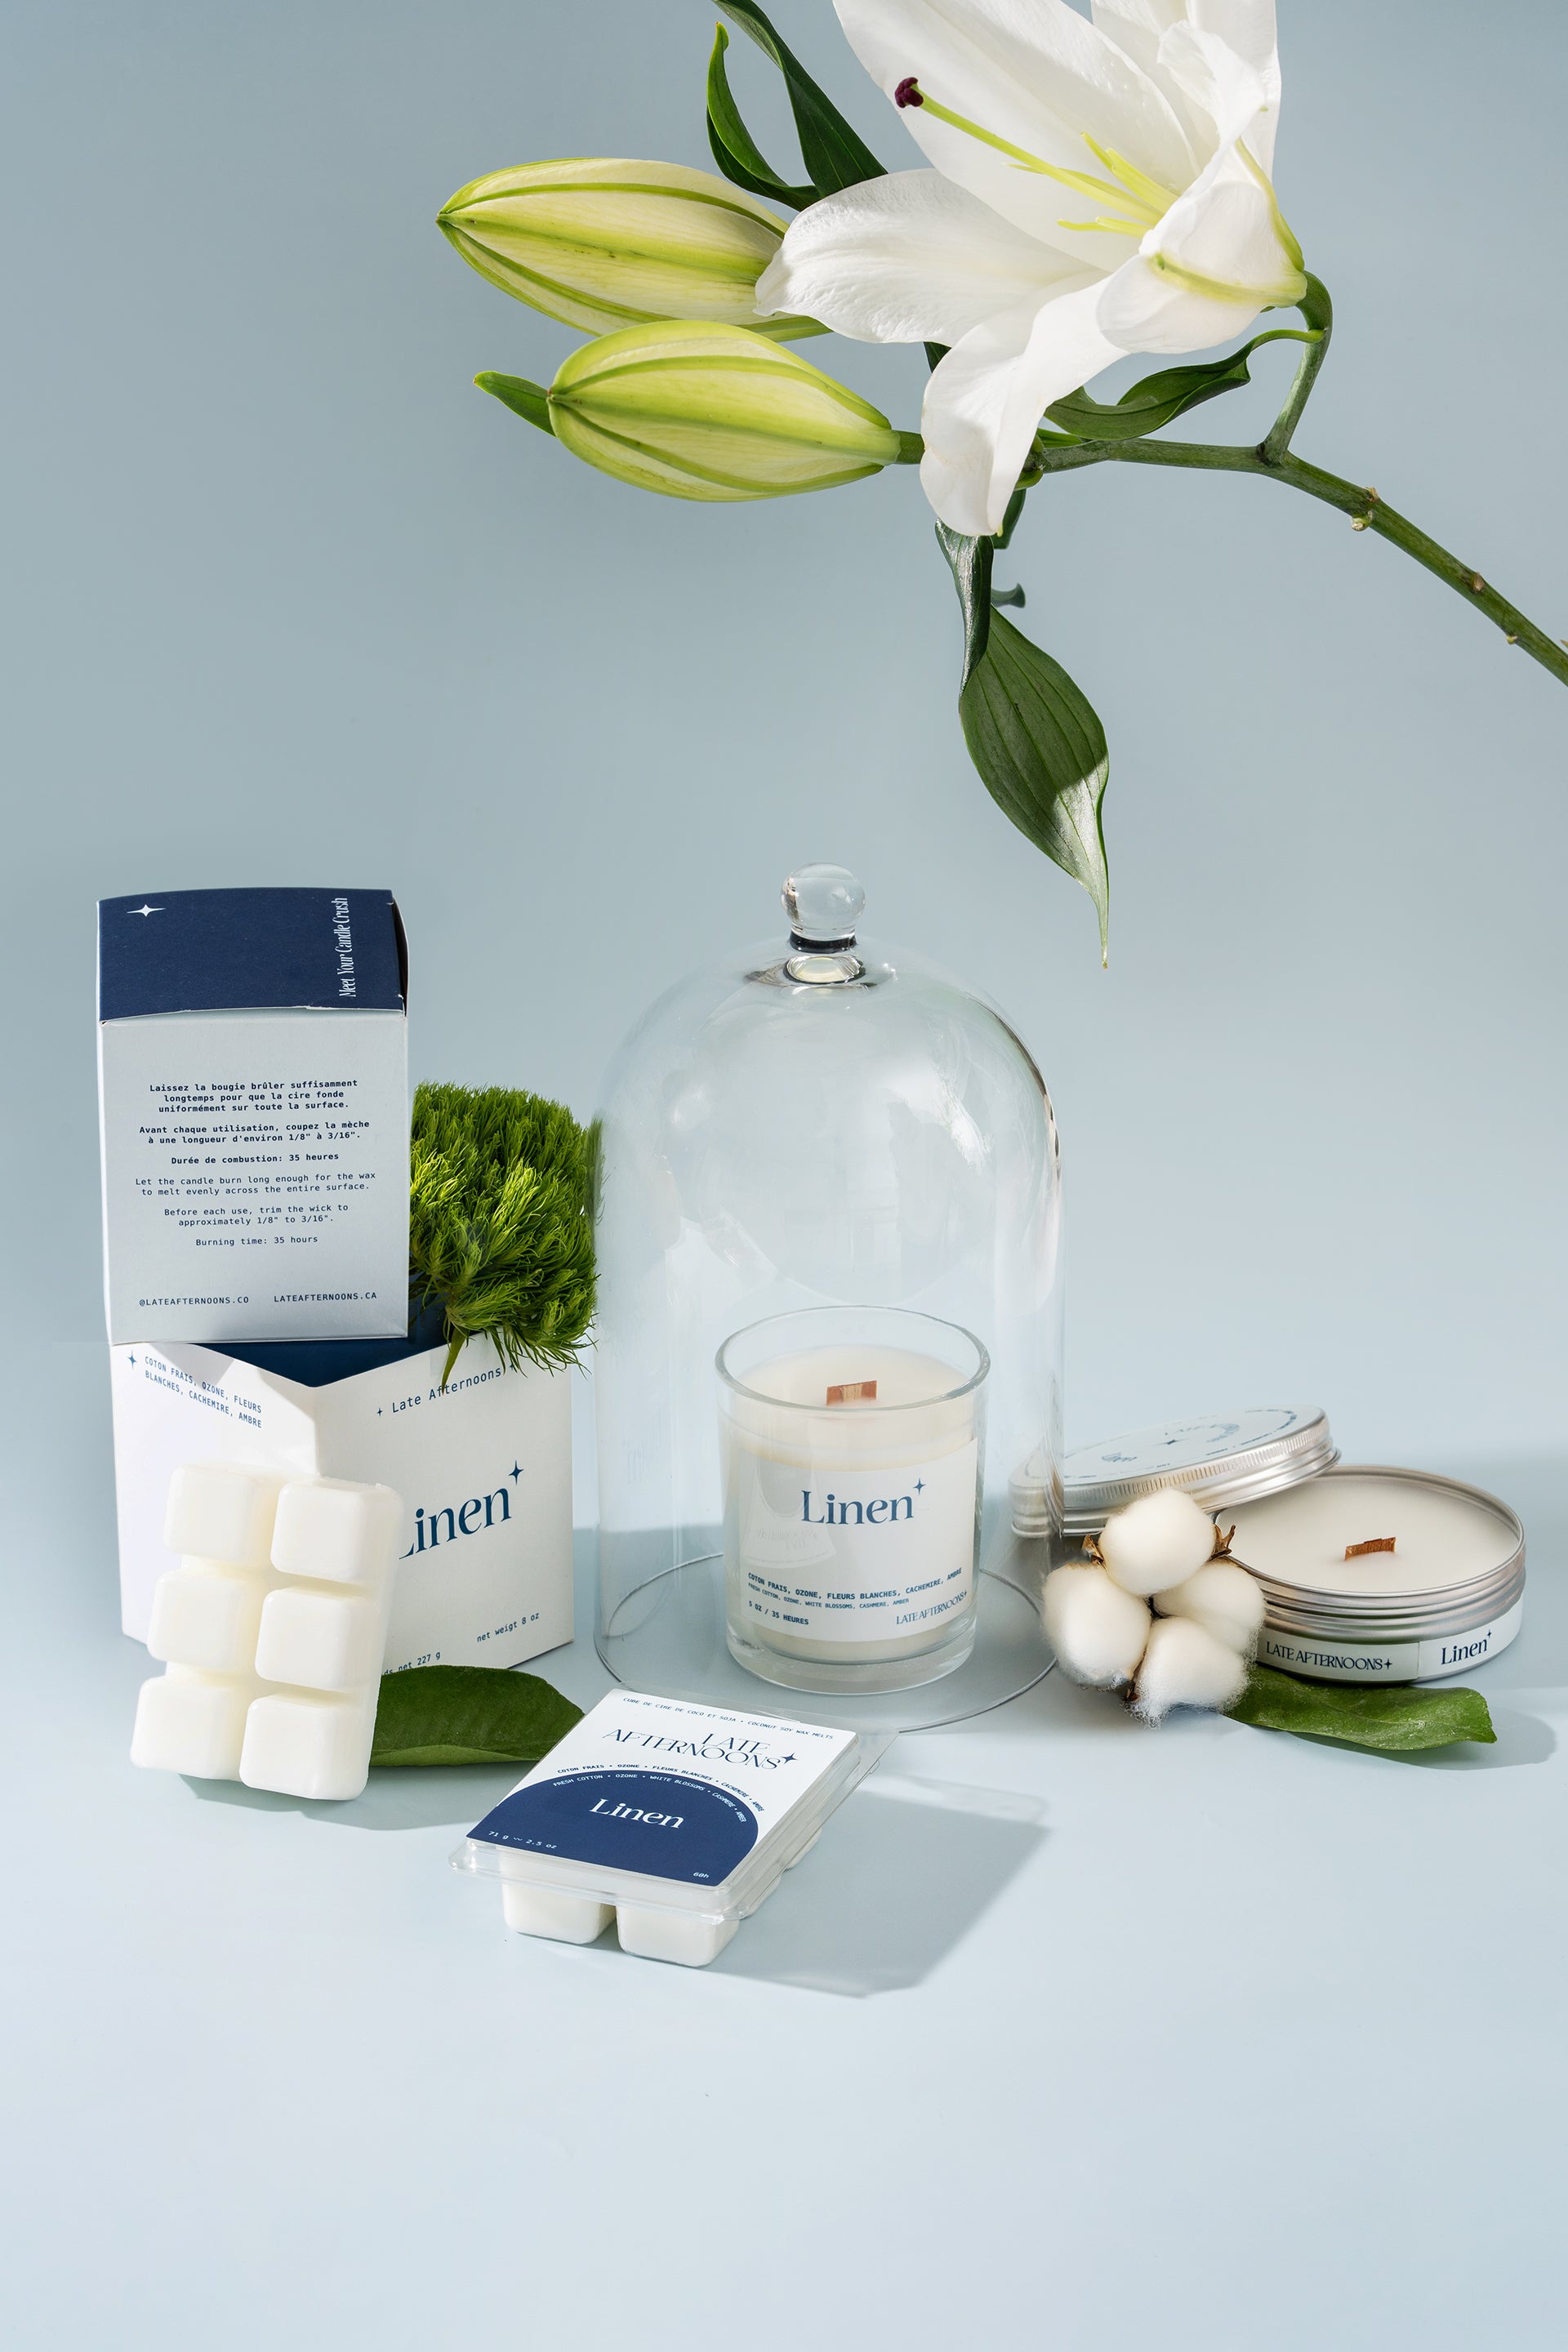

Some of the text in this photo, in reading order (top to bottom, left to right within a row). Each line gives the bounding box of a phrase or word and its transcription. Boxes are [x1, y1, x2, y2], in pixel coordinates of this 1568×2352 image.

[332, 898, 356, 996] Meet Your Candle Crush
[149, 1080, 358, 1092] Laissez la bougie brûler suffisamment
[164, 1094, 215, 1103] longtemps
[220, 1094, 242, 1102] pour
[248, 1094, 265, 1102] que
[271, 1092, 283, 1100] la
[287, 1091, 310, 1099] cire
[158, 1103, 225, 1112] uniformément
[255, 1102, 283, 1111] toute
[288, 1102, 299, 1110] la
[305, 1101, 349, 1109] surface.
[173, 1125, 207, 1134] chaque
[212, 1124, 279, 1133] utilisation,
[286, 1122, 318, 1131] coupez
[341, 1120, 370, 1129] mèche
[182, 1134, 227, 1144] longueur
[233, 1134, 283, 1142] d'environ
[288, 1133, 310, 1141] 1/8"
[327, 1131, 360, 1139] 3/16".
[222, 1155, 283, 1163] combustion:
[288, 1153, 300, 1161] 35
[180, 1177, 214, 1185] candle
[247, 1175, 270, 1184] long
[275, 1174, 309, 1183] enough
[315, 1173, 332, 1181] for
[158, 1187, 180, 1196] melt
[186, 1187, 220, 1196] evenly
[265, 1185, 281, 1193] the
[287, 1184, 320, 1192] entire
[326, 1183, 369, 1191] surface.
[164, 1208, 198, 1216] Before
[203, 1207, 225, 1215] each
[309, 1204, 332, 1212] wick
[178, 1217, 252, 1227] approximately
[301, 1215, 333, 1223] 3/16".
[196, 1238, 234, 1247] Burning
[139, 1296, 249, 1307] @LATEAFTERNOONS.CO
[274, 1292, 376, 1303] LATEAFTERNOONS.CA
[145, 1356, 261, 1414] COTON FRAIS, OZONE, FLEURS
[392, 1367, 501, 1413] Late Afternoons
[145, 1370, 261, 1428] BLANCHES, CACHEMIRE, AMBRE
[800, 1490, 914, 1525] Linen
[399, 1488, 512, 1560] inen
[748, 1573, 764, 1585] COTON
[768, 1581, 791, 1594] FRAIS,
[795, 1589, 822, 1599] OZONE,
[860, 1590, 900, 1599] BLANCHES,
[906, 1579, 943, 1594] CACHEMIRE,
[947, 1568, 962, 1580] AMBRE
[897, 1591, 964, 1624] LATE AFTERNOONS
[783, 1615, 808, 1624] HEURES
[477, 1633, 490, 1642] net
[495, 1621, 517, 1636] weigt
[531, 1613, 539, 1621] oz
[1266, 1642, 1383, 1671] LATE AFTERNOONS
[1441, 1638, 1488, 1665] Linen
[417, 1655, 430, 1665] 227
[748, 1721, 777, 1729] COCONUT
[602, 1729, 781, 1770] AFTERNOONS
[701, 1733, 771, 1754] LATE
[681, 1770, 712, 1781] BLANCHES
[675, 1780, 706, 1791] BLOSSOMS
[590, 1798, 684, 1829] Linen
